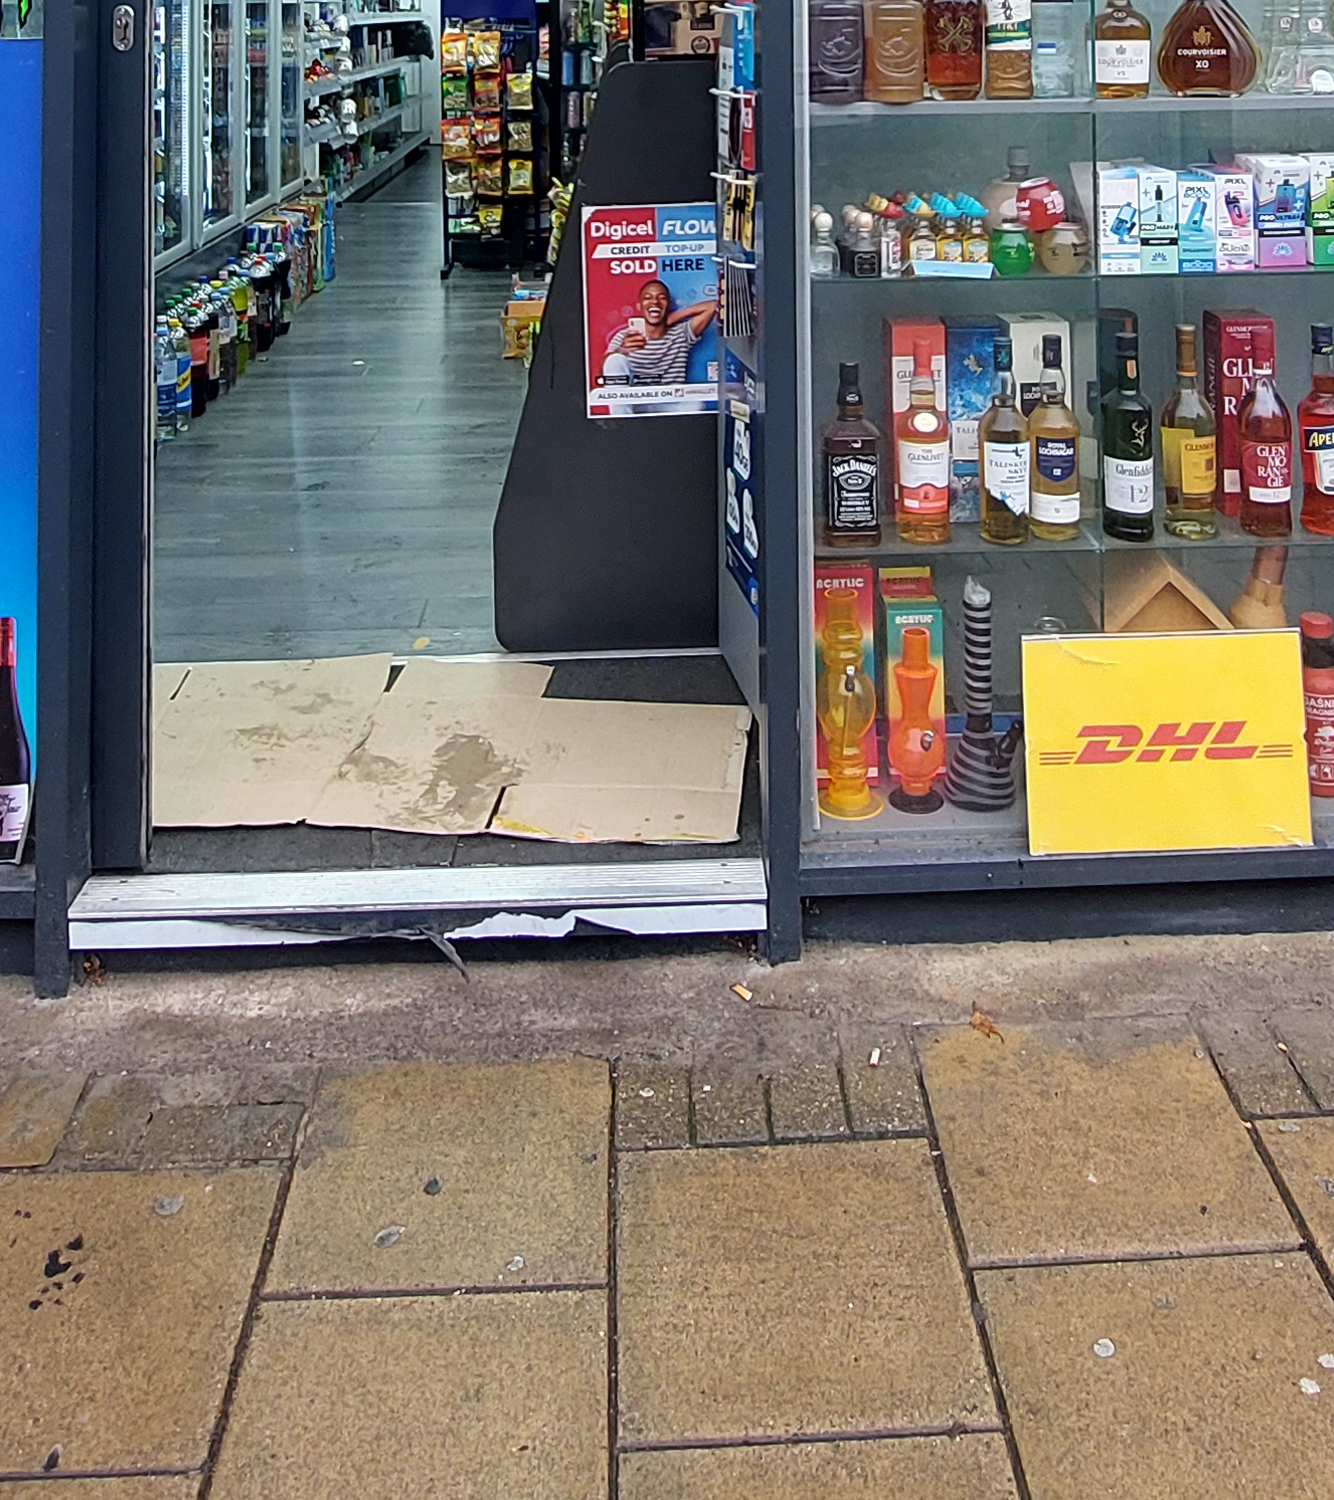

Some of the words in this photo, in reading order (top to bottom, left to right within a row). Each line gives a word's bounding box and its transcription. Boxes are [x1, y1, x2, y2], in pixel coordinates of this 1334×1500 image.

[1194, 58, 1210, 70] XO
[590, 220, 654, 241] Digicel
[610, 245, 650, 255] CREDIT
[665, 243, 705, 253] TOP-UP
[610, 259, 657, 275] SOLD
[661, 258, 705, 272] HERE
[597, 390, 618, 400] ALSO
[619, 390, 660, 399] AVAILABLE
[660, 390, 673, 398] ON
[907, 452, 945, 462] GLENLIVET
[1256, 445, 1286, 457] GLEN
[1268, 456, 1287, 466] MO
[1257, 465, 1281, 477] RAN
[1267, 476, 1285, 487] GIE
[816, 577, 865, 589] ACRYLIC
[1075, 721, 1259, 764] DHL
